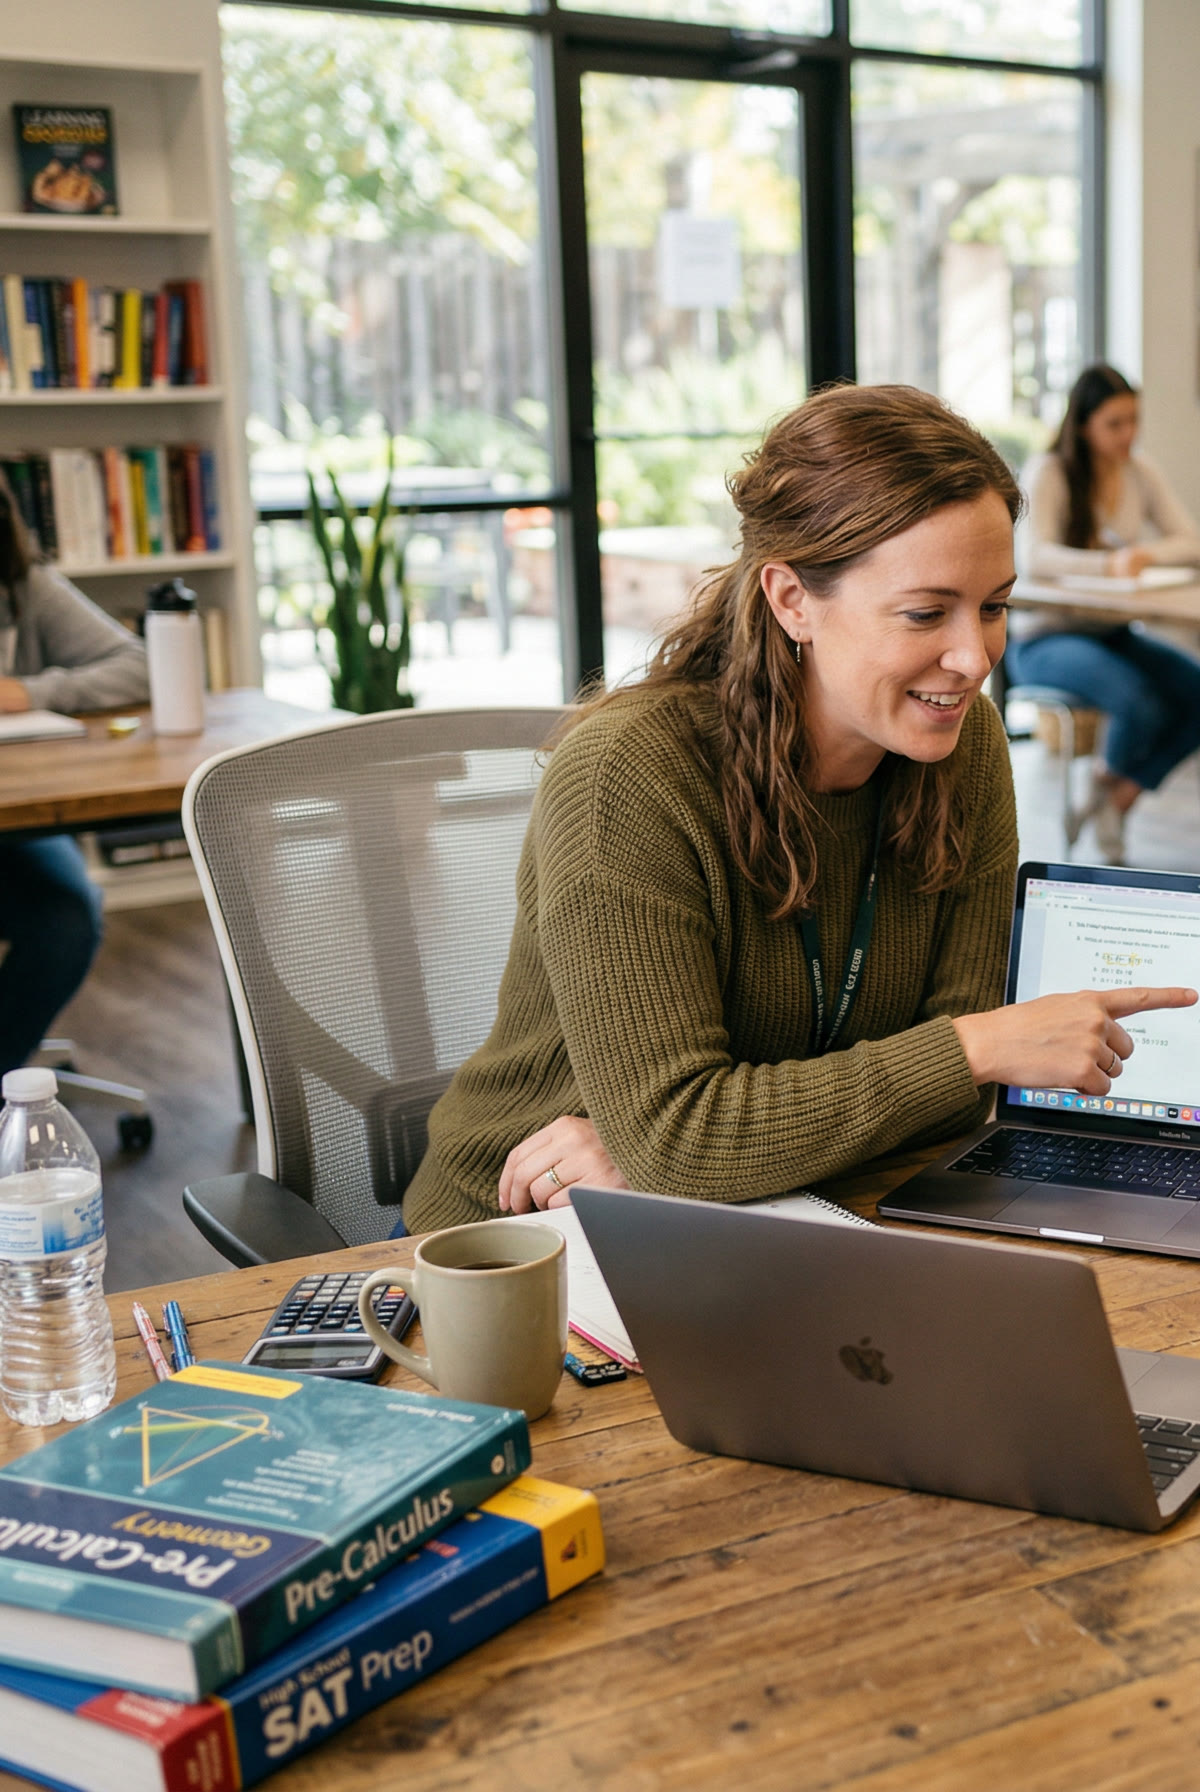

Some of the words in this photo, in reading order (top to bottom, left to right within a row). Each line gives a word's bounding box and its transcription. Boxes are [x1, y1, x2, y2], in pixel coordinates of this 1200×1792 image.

[111, 1510, 273, 1559] Geometry
[283, 1486, 455, 1624] Pre-Calculus
[262, 1667, 354, 1758] SAT
[359, 1630, 434, 1691] Prep
